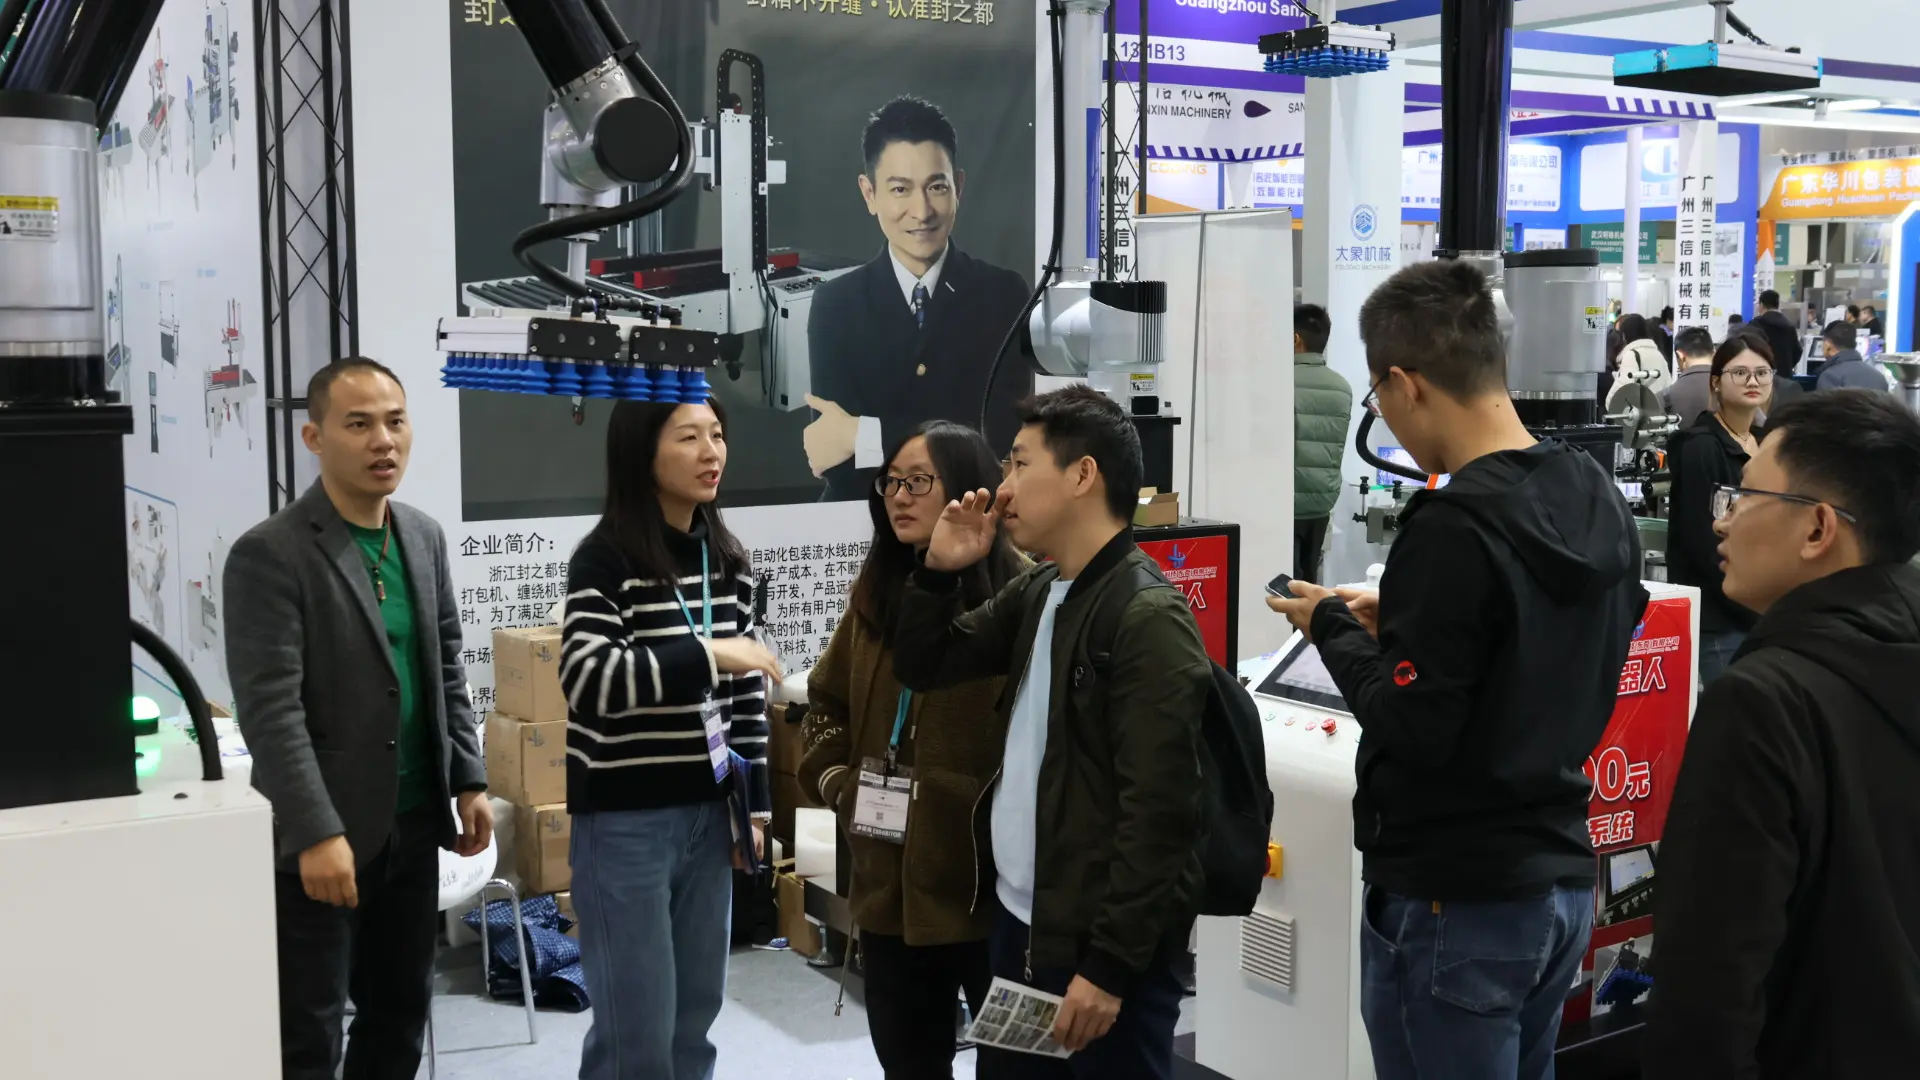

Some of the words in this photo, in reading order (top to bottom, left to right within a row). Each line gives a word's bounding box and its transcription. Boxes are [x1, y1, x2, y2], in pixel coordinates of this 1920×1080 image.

[464, 0, 516, 26] 封
[1121, 41, 1185, 61] 131B13
[1171, 106, 1231, 119] MACHINERY
[1336, 246, 1392, 261] 大象机械
[752, 541, 870, 563] 自动化包装流水线的研
[751, 560, 865, 583] 低生产成本。在不断
[463, 648, 494, 666] 市场
[1617, 656, 1666, 695] 器人
[1583, 747, 1651, 801] 0元
[1586, 810, 1635, 847] 系统
